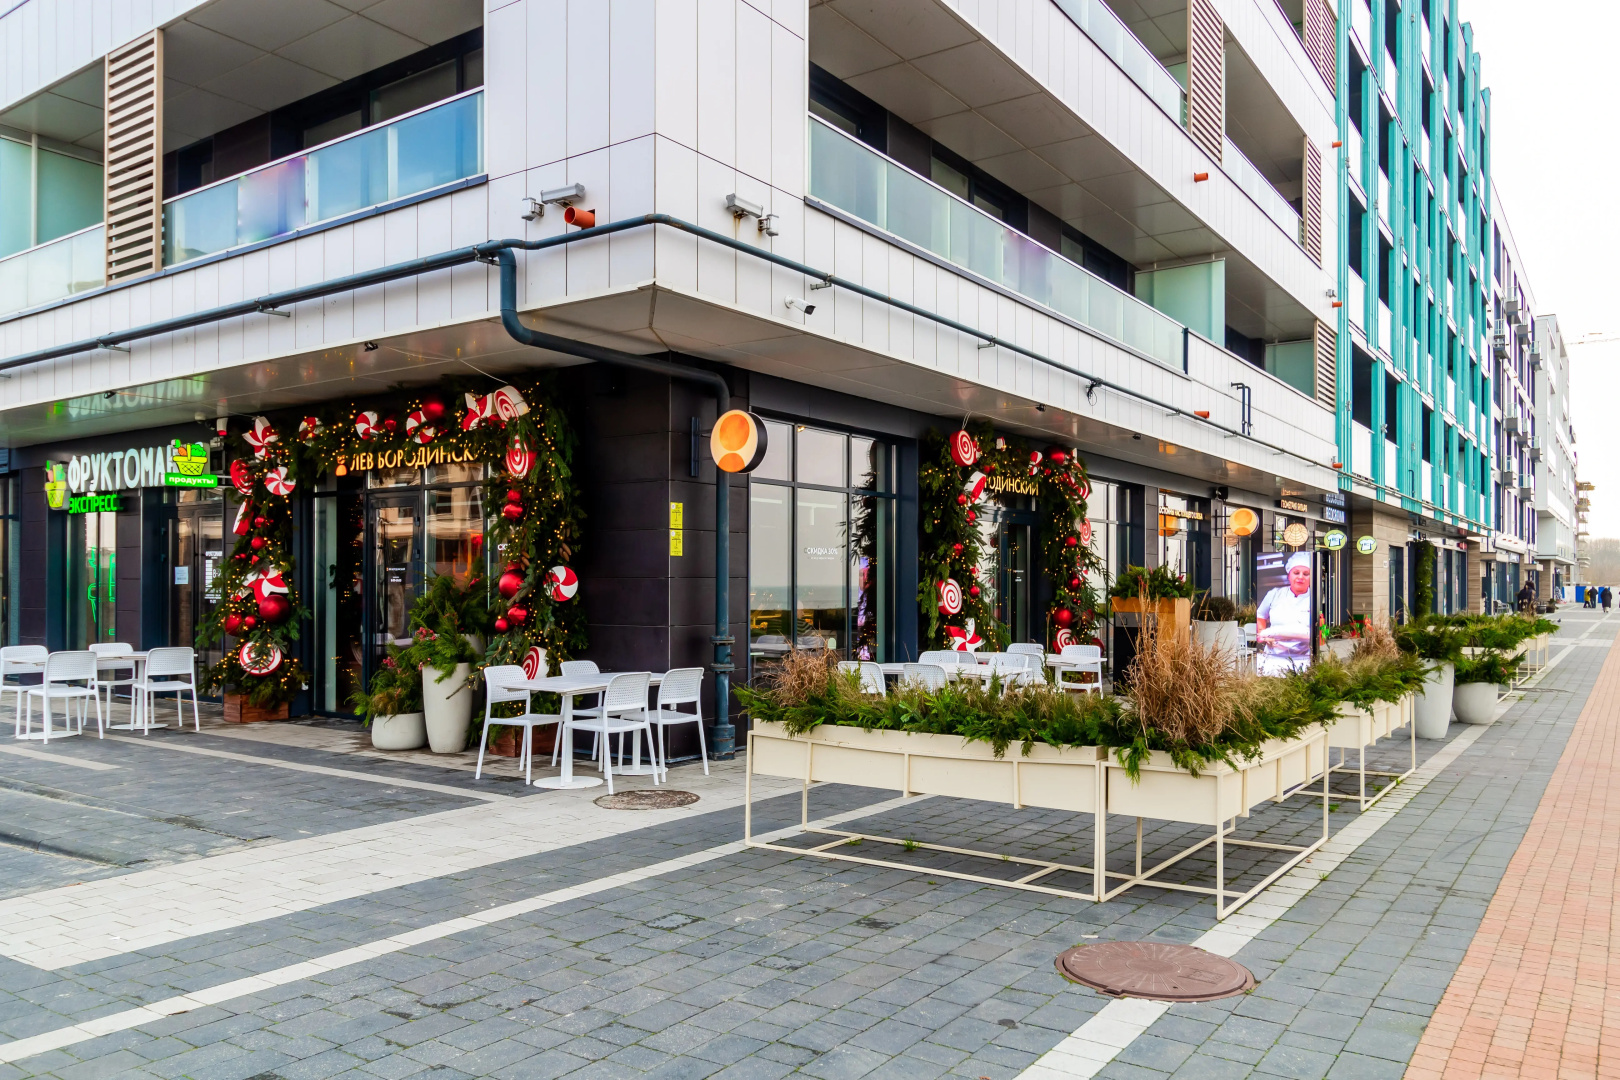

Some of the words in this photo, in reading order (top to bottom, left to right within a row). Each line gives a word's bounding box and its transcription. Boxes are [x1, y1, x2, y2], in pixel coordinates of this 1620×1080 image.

[350, 452, 374, 471] ЛЕВ
[378, 446, 477, 469] БОРОДИНСК
[168, 476, 214, 485] продукты
[68, 494, 118, 514] ЭКСПРЕСС
